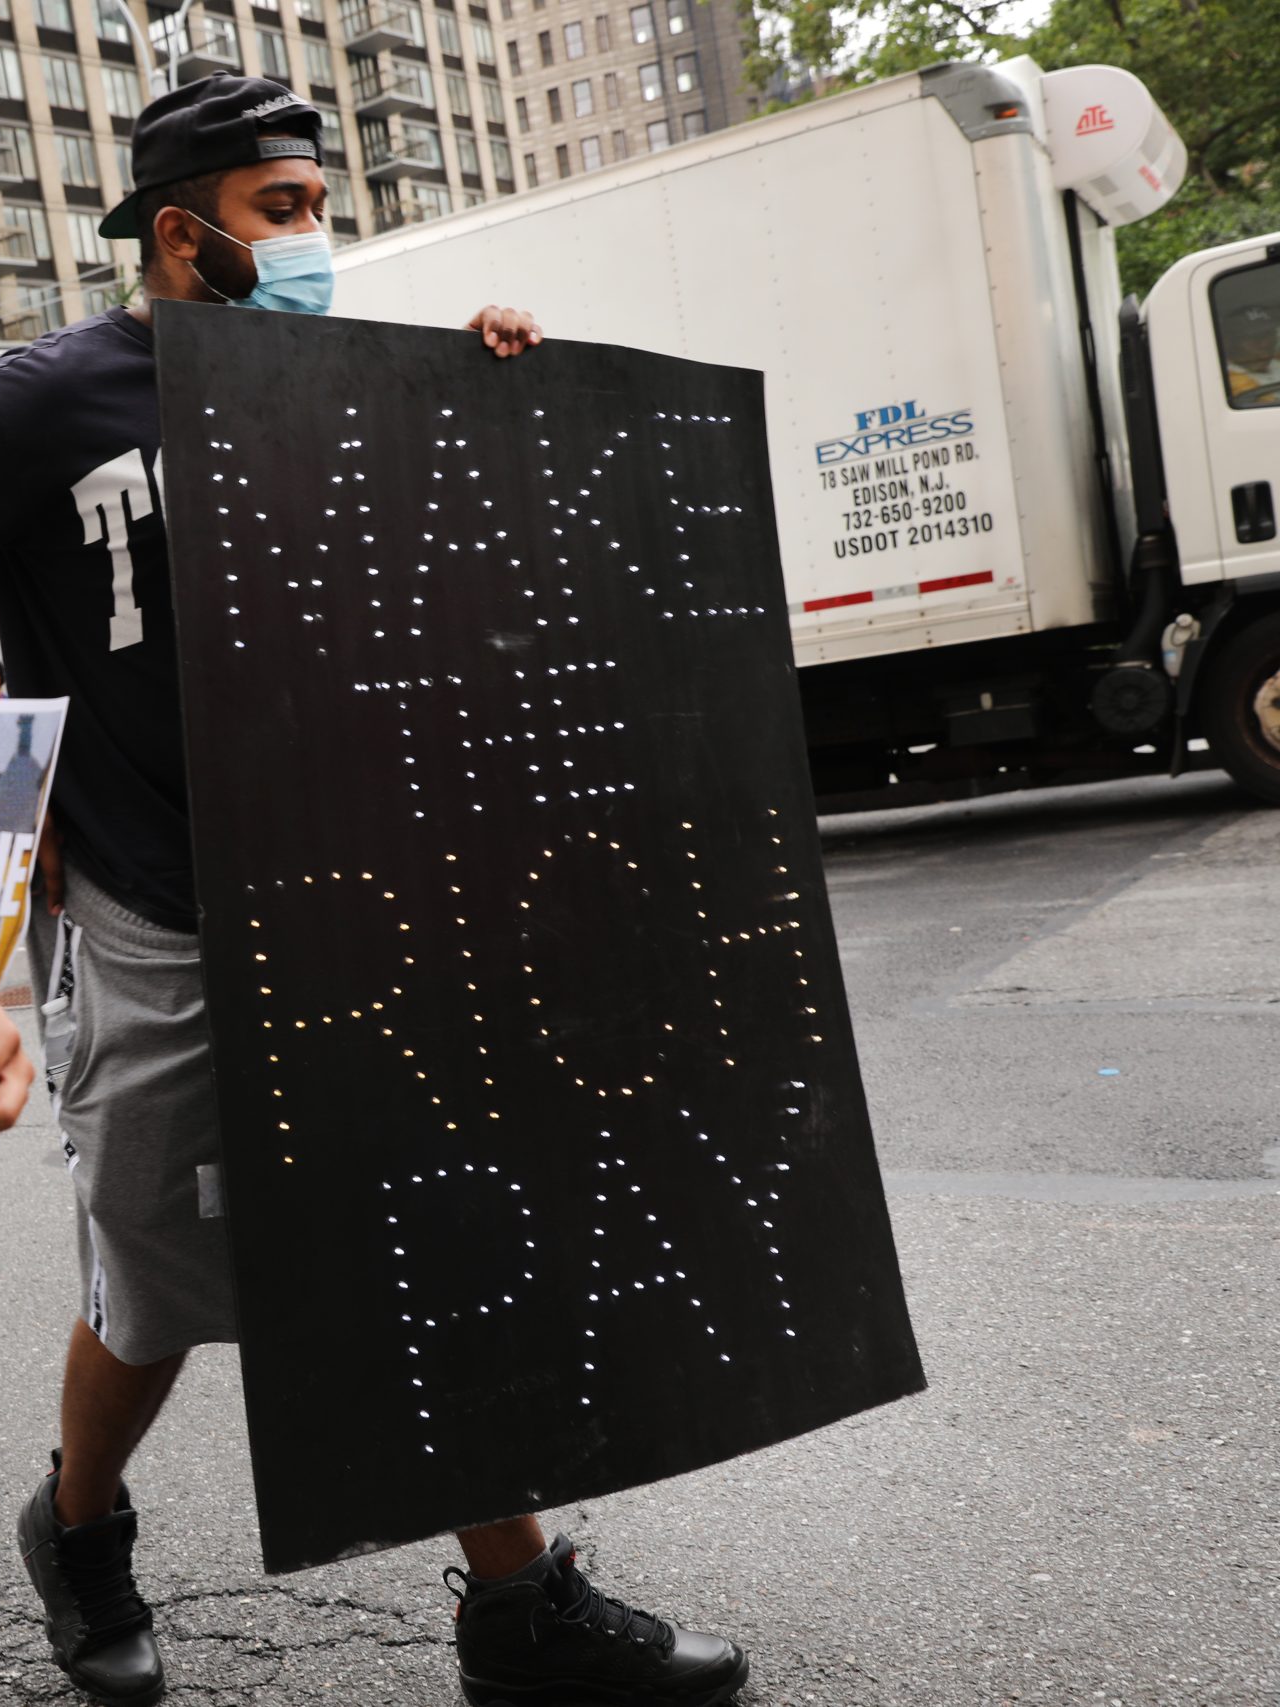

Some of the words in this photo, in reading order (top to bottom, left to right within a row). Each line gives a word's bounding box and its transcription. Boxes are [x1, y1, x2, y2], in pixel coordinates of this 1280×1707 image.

[815, 412, 974, 465] EXPRESS
[853, 399, 926, 432] FDL
[820, 469, 837, 490] 78
[841, 463, 870, 486] SAW
[875, 455, 910, 480] MILL
[913, 446, 951, 472] POND
[955, 442, 980, 464] RD.
[853, 479, 915, 507] EDISON,
[919, 472, 951, 495] N.J.
[205, 407, 765, 657] MAKE
[834, 530, 900, 558] USDOT
[908, 512, 993, 546] 2014310
[842, 491, 967, 531] 732-650-9200
[354, 660, 636, 819] THE
[244, 808, 823, 1165] RICH
[381, 1080, 807, 1454] PAY
